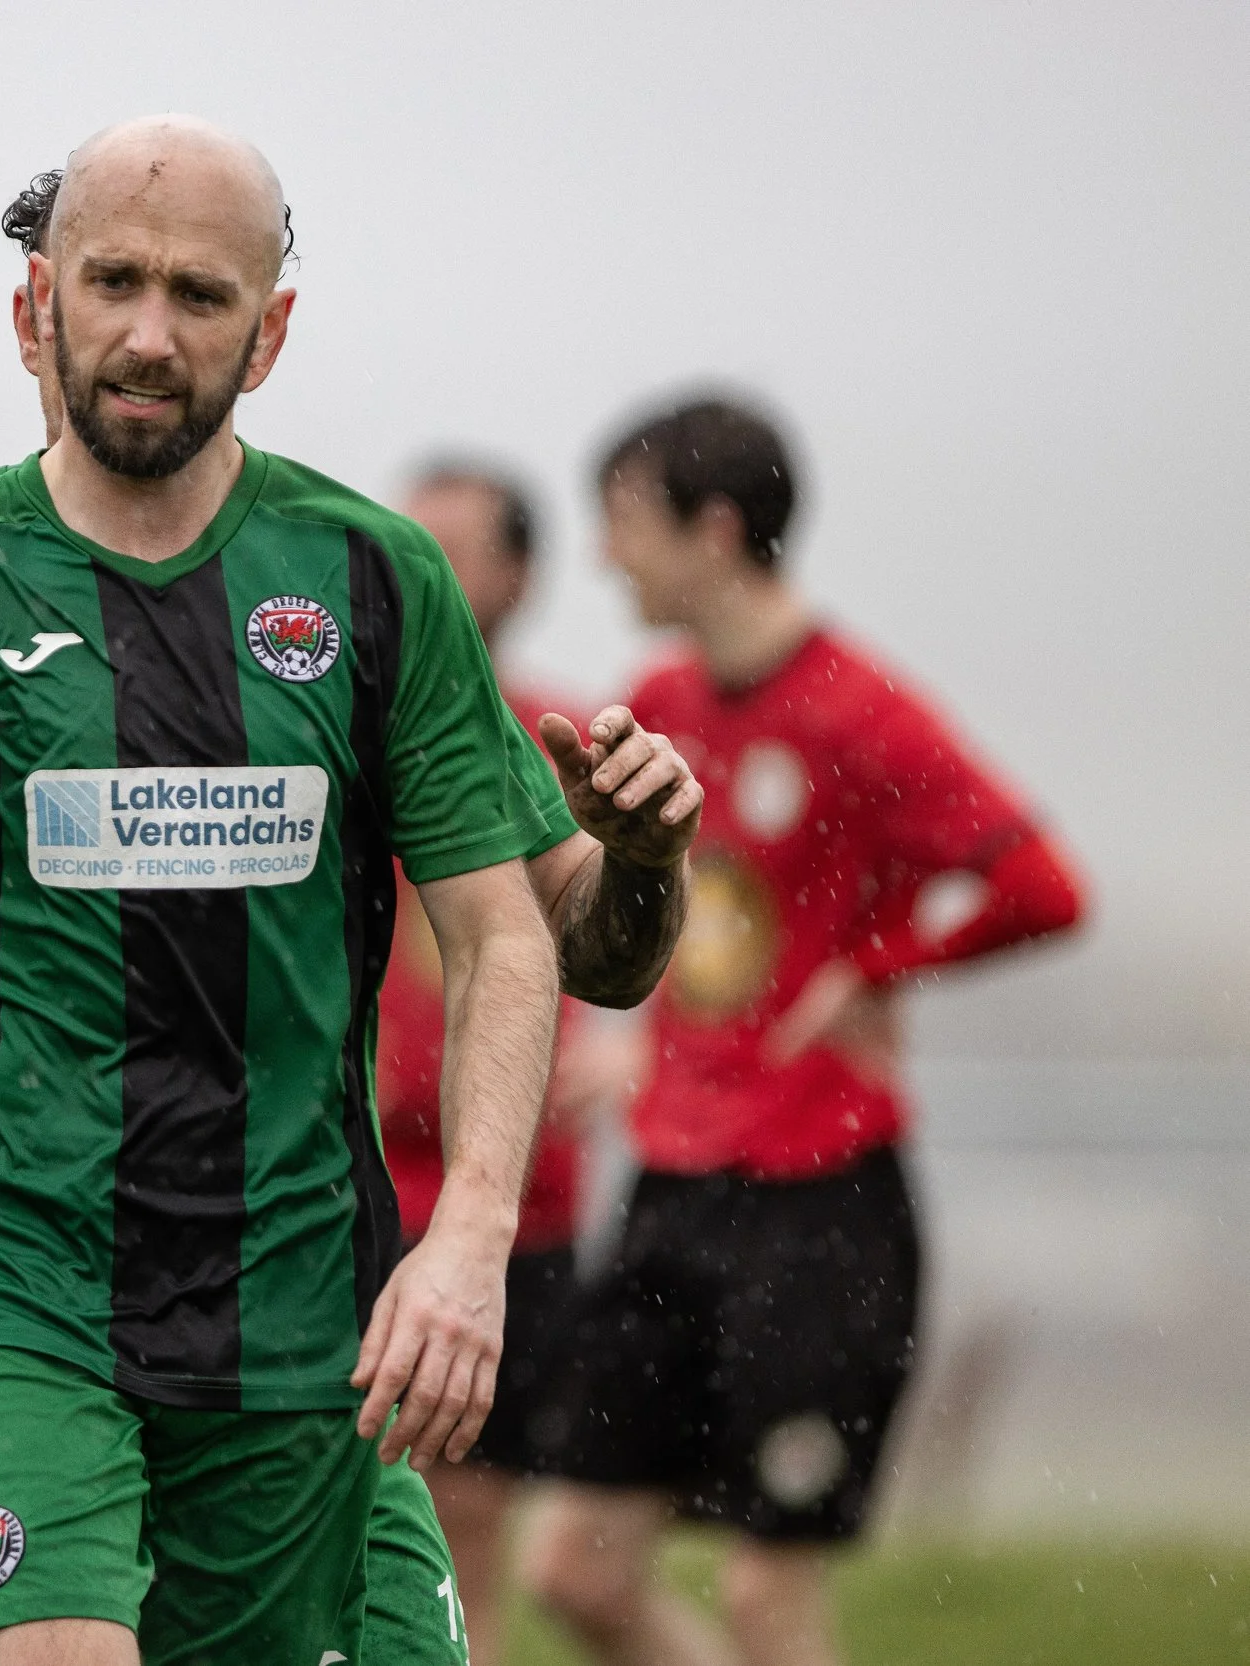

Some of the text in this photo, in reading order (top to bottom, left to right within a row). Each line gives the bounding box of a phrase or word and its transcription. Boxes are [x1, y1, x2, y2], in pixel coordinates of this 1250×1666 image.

[110, 778, 286, 811] Lakeland
[112, 814, 315, 847] Verandahs
[38, 853, 310, 877] DECKING FENCING PERGOLAS
